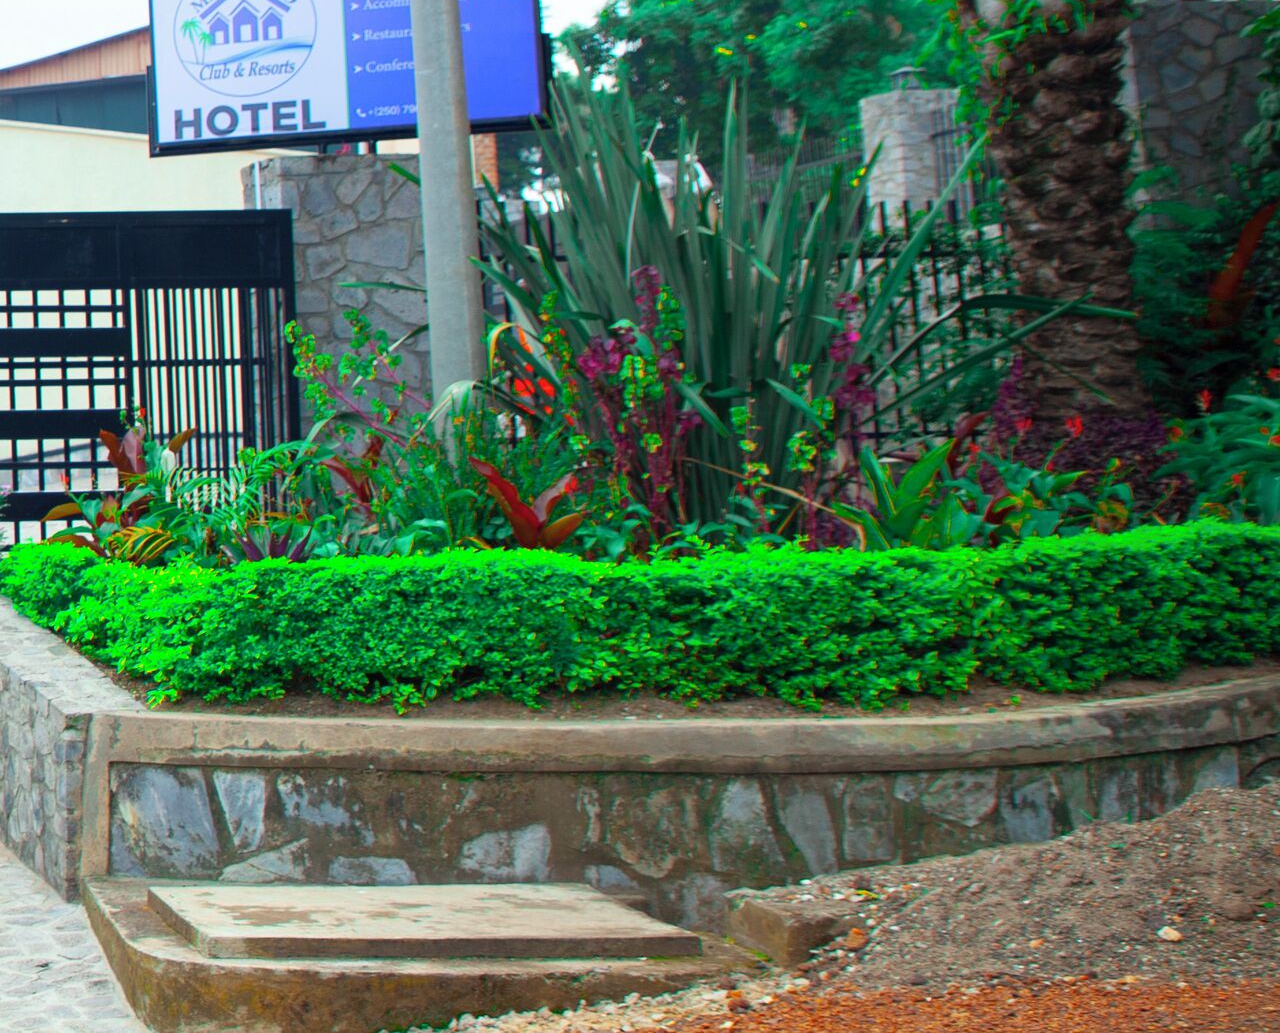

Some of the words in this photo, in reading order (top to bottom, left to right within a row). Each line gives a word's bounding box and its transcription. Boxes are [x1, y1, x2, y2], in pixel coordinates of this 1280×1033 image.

[199, 62, 230, 82] Club
[233, 62, 245, 78] &
[248, 59, 296, 77] Resorts
[365, 58, 415, 74] Confere
[174, 98, 327, 141] HOTEL
